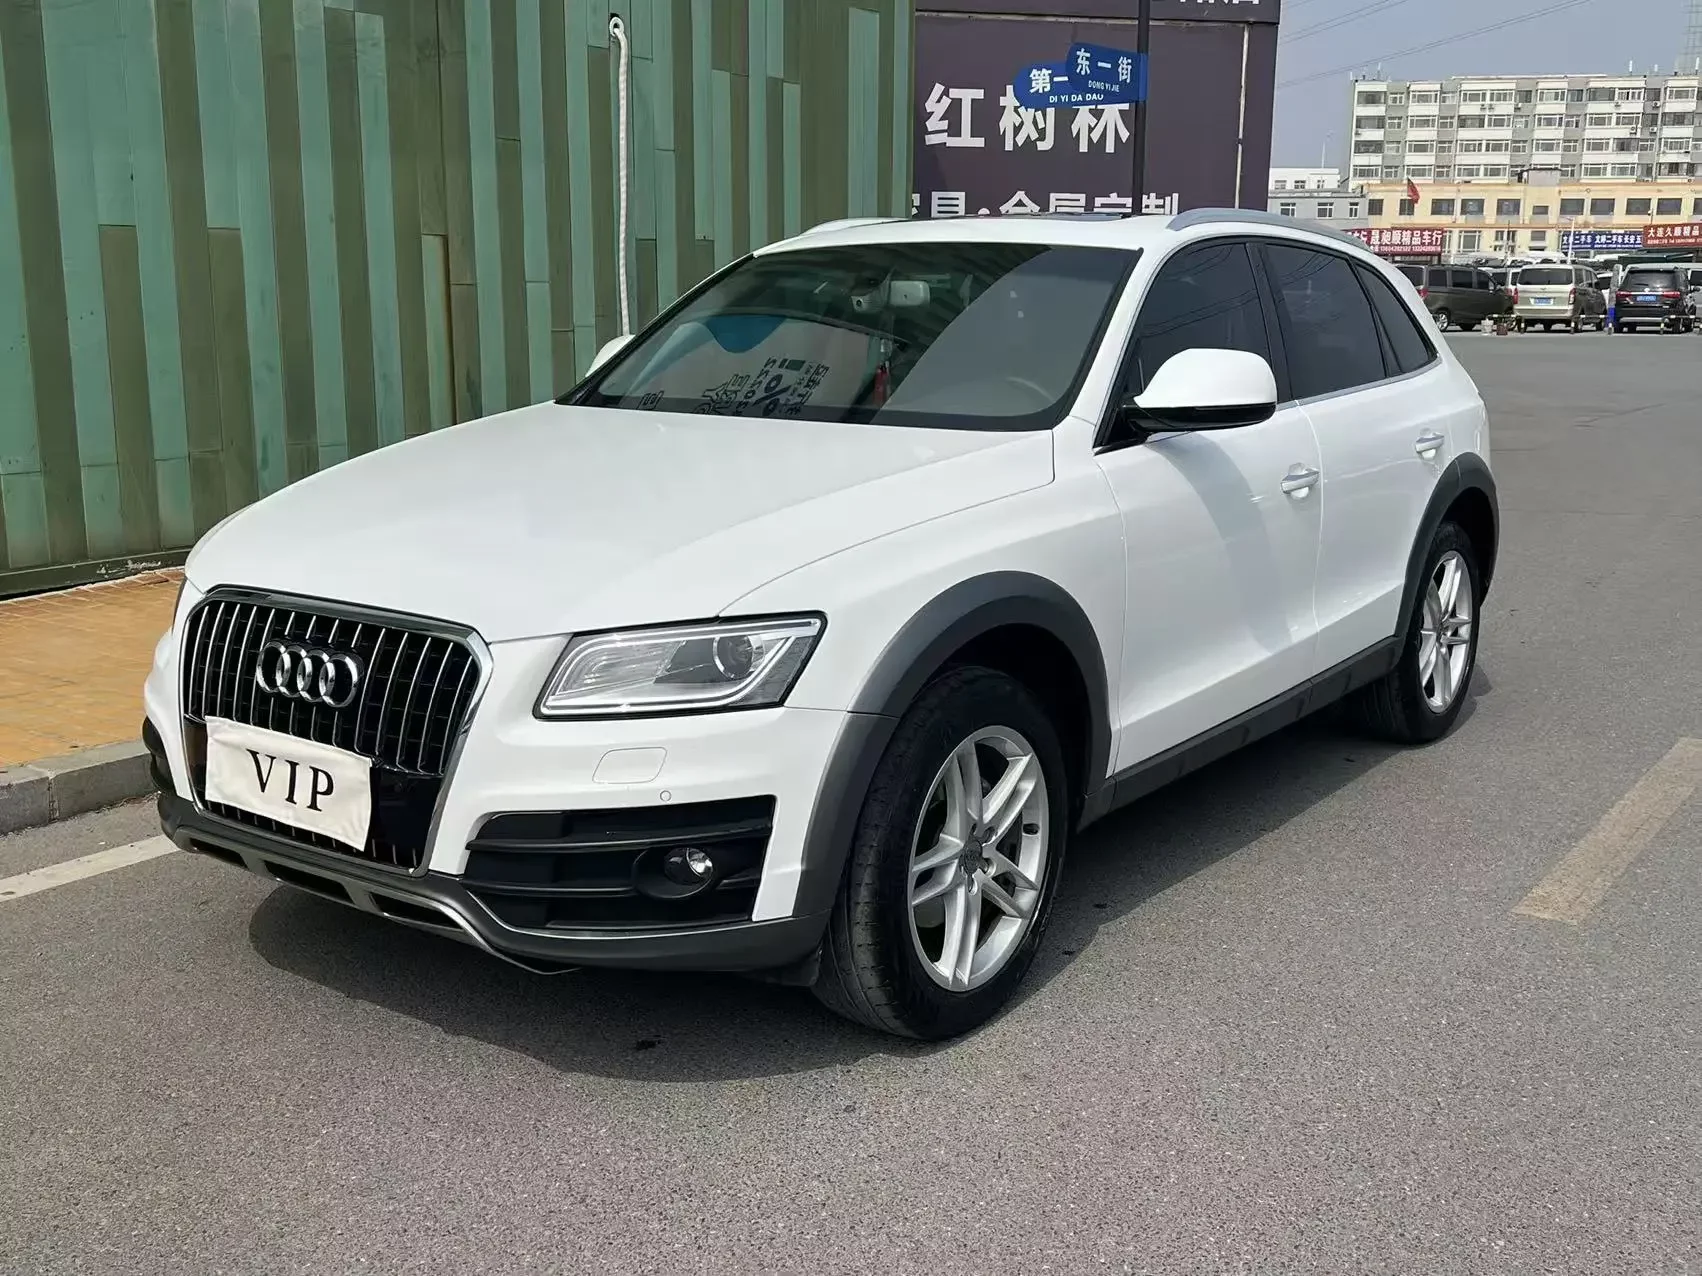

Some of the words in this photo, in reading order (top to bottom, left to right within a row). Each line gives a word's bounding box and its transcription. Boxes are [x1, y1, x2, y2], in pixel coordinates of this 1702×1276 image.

[1076, 48, 1132, 83] 东一街
[1049, 95, 1058, 103] DI
[1071, 94, 1082, 102] DA
[1086, 93, 1104, 101] DAO
[1088, 80, 1104, 90] DONG
[1111, 84, 1120, 92] JIE
[924, 82, 1131, 153] 红树林
[246, 749, 334, 812] VIP
